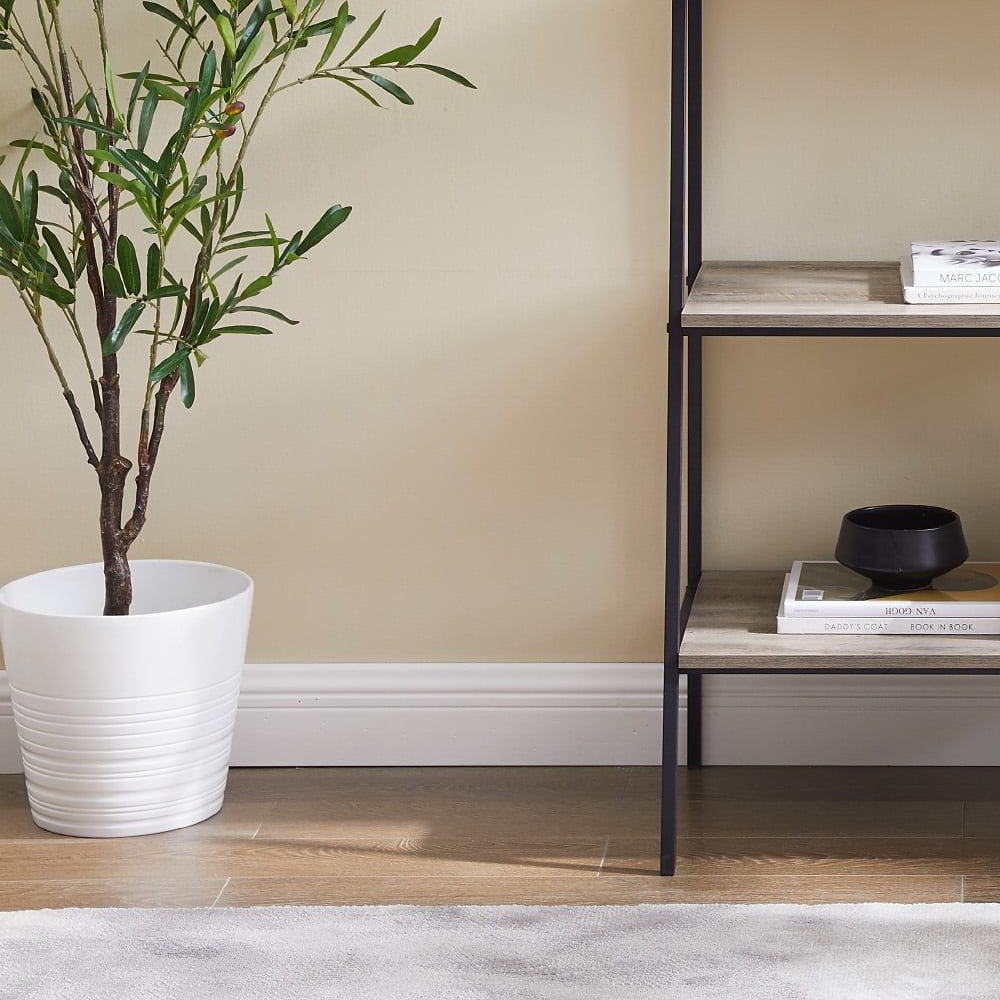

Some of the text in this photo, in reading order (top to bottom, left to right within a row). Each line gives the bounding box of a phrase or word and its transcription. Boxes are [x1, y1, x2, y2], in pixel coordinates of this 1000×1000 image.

[940, 273, 973, 283] MARC
[824, 623, 888, 631] DADDY'S COAT
